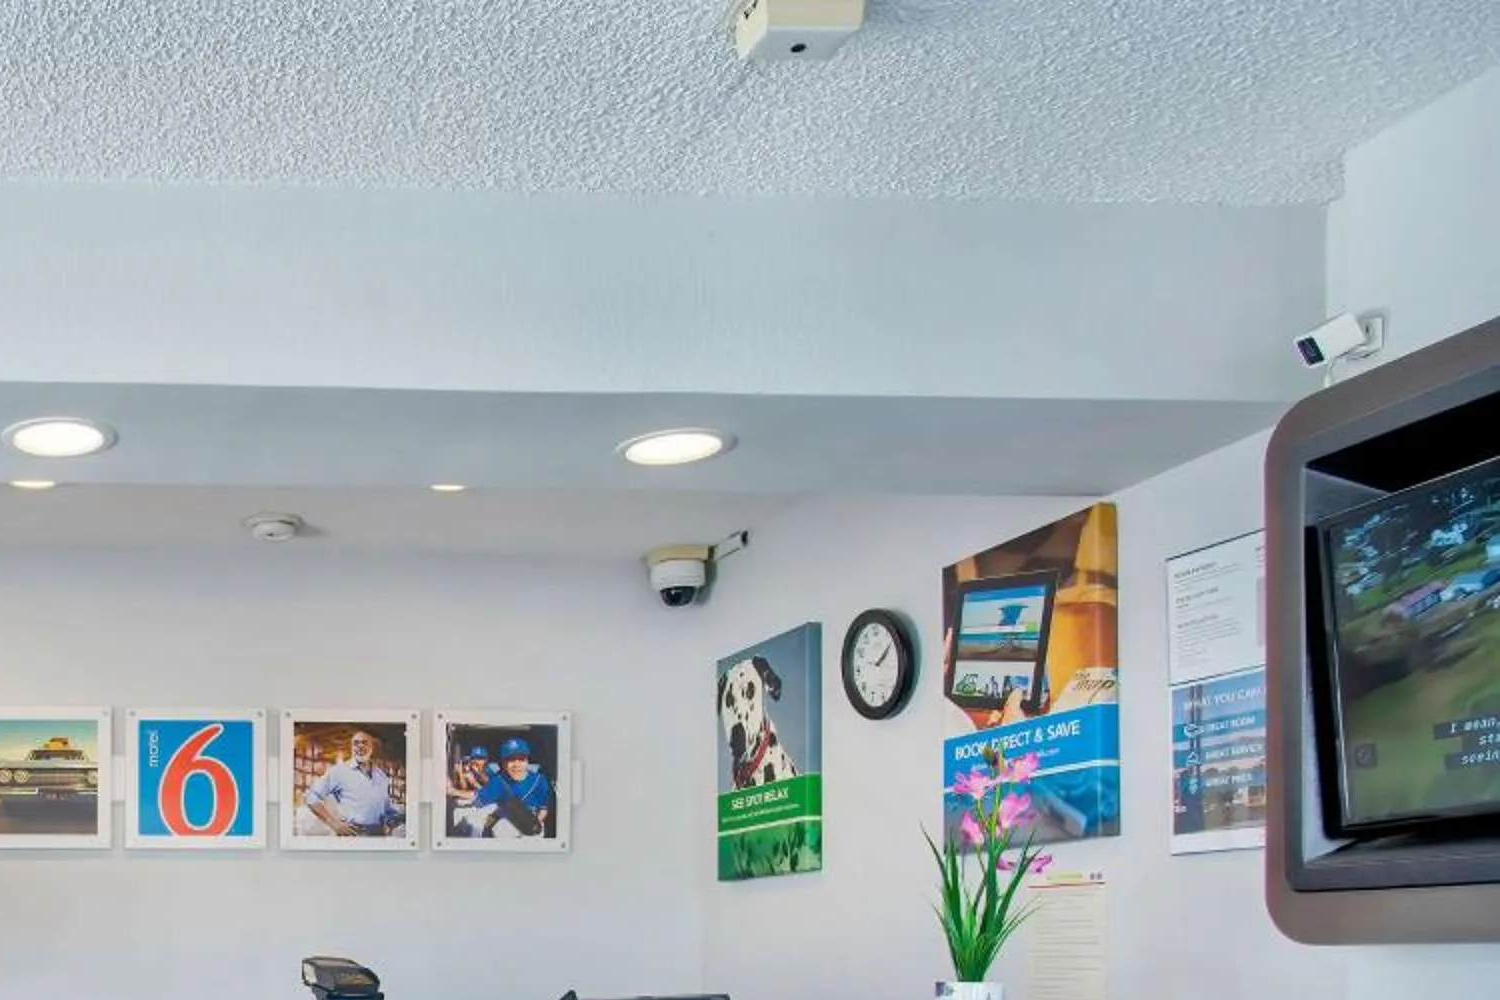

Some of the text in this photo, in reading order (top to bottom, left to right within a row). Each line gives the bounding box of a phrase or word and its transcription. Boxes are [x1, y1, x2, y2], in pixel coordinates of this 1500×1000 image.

[954, 740, 988, 761] BOOK
[1047, 719, 1081, 740] SAVE
[157, 723, 239, 837] 6
